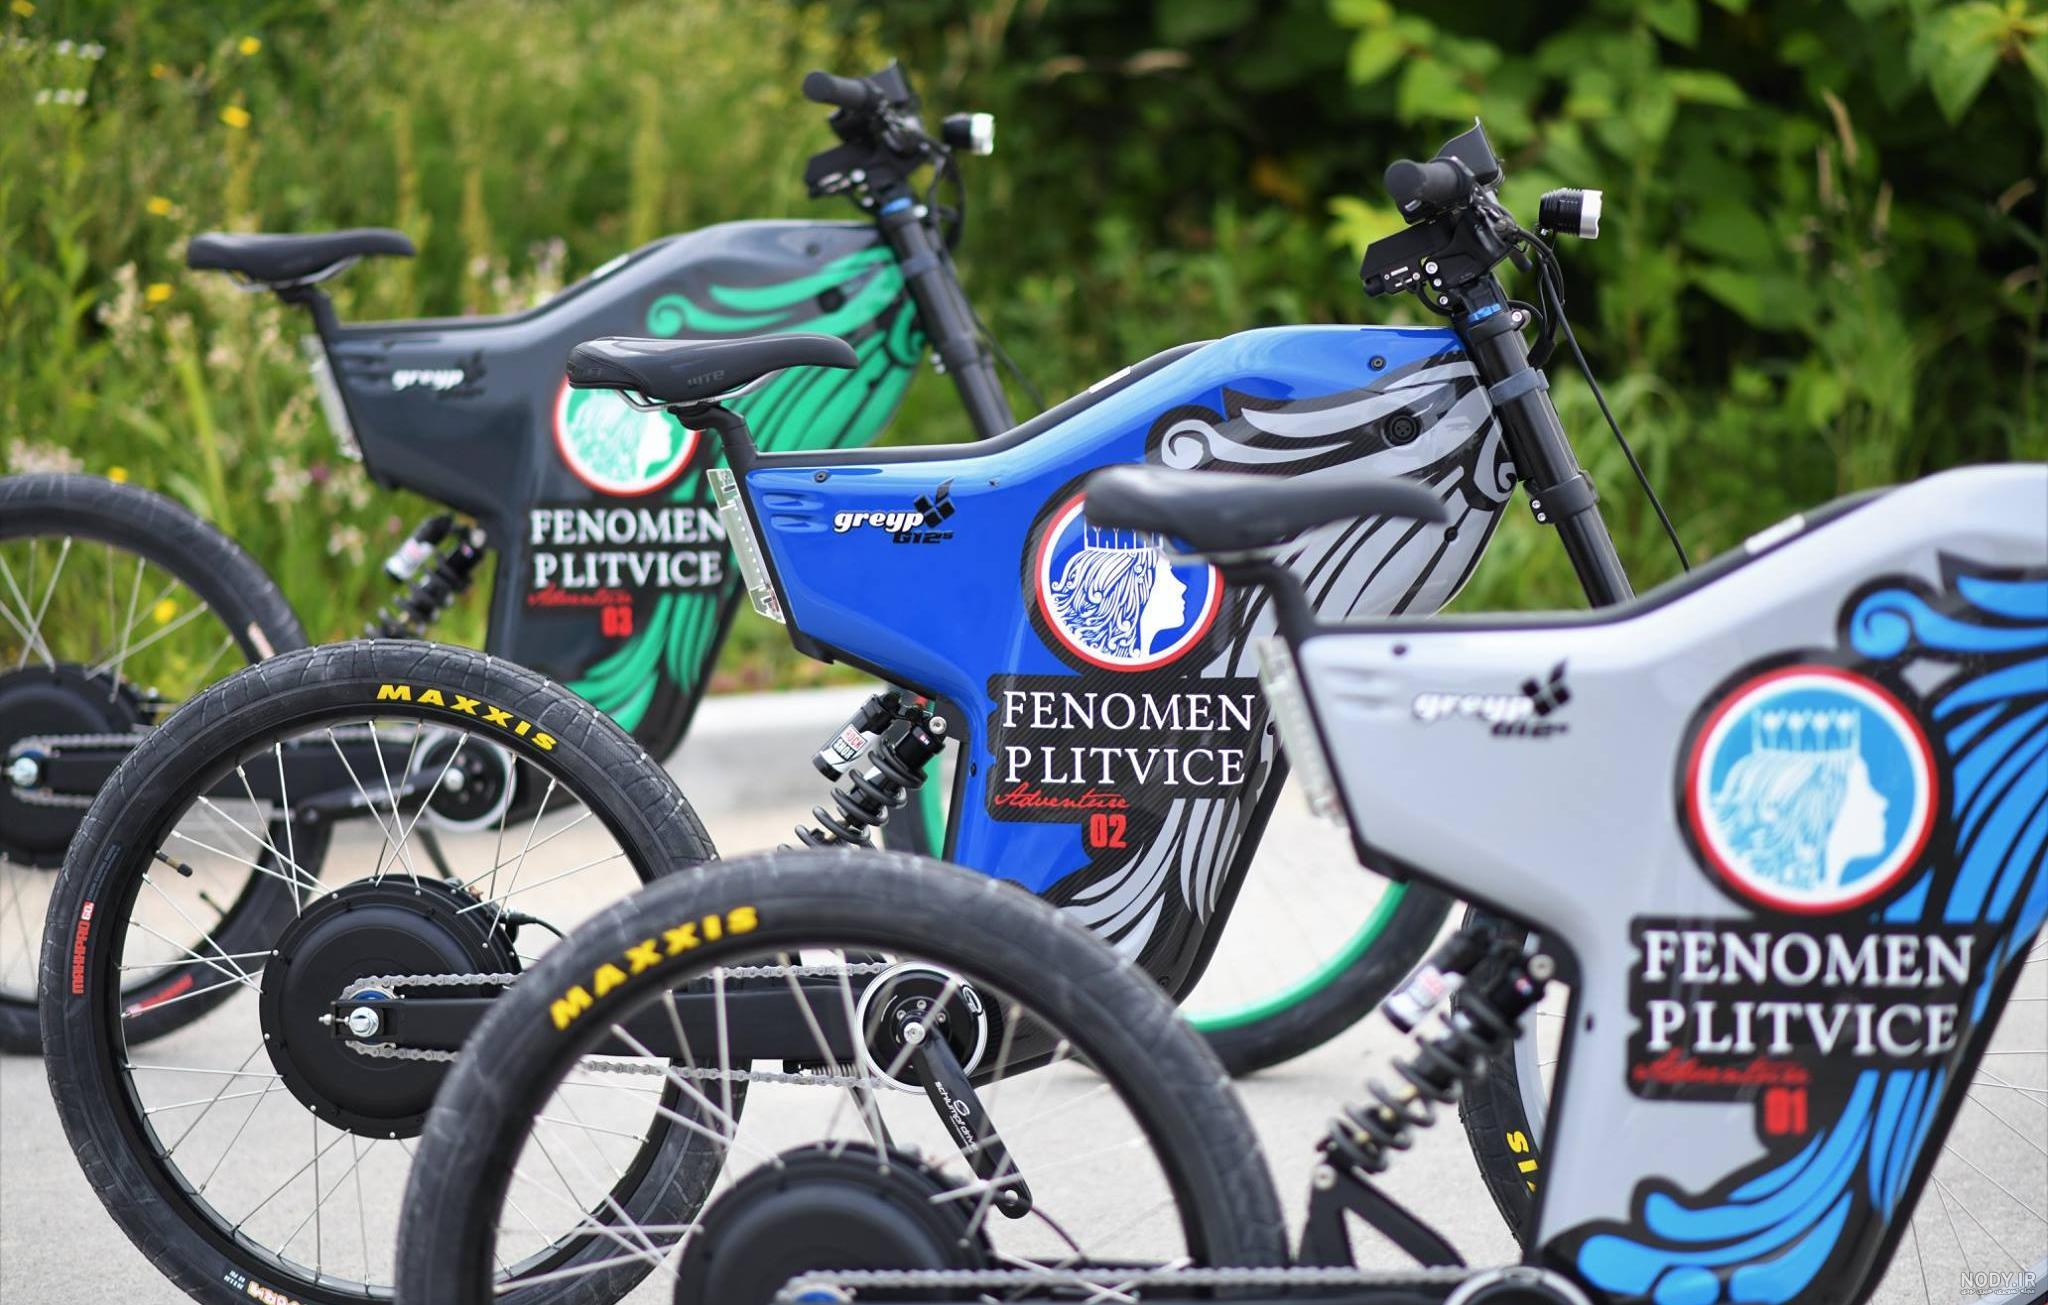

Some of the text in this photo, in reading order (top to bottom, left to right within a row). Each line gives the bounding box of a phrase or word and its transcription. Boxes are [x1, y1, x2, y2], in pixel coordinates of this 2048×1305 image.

[530, 508, 727, 545] FENOMEN
[833, 511, 925, 532] greyp
[534, 550, 724, 588] PLITVICE
[602, 605, 633, 637] 03
[376, 684, 558, 750] MAXXIS
[1002, 690, 1256, 732] FENOMEN
[1004, 745, 1246, 786] PLITVICE
[994, 780, 1131, 810] Adventure
[1090, 813, 1127, 848] 02
[550, 906, 758, 1031] MAXXIS
[1642, 930, 1976, 987] FENOMEN
[1646, 1000, 1959, 1057] PLITVICE
[1764, 1086, 1807, 1136] 01
